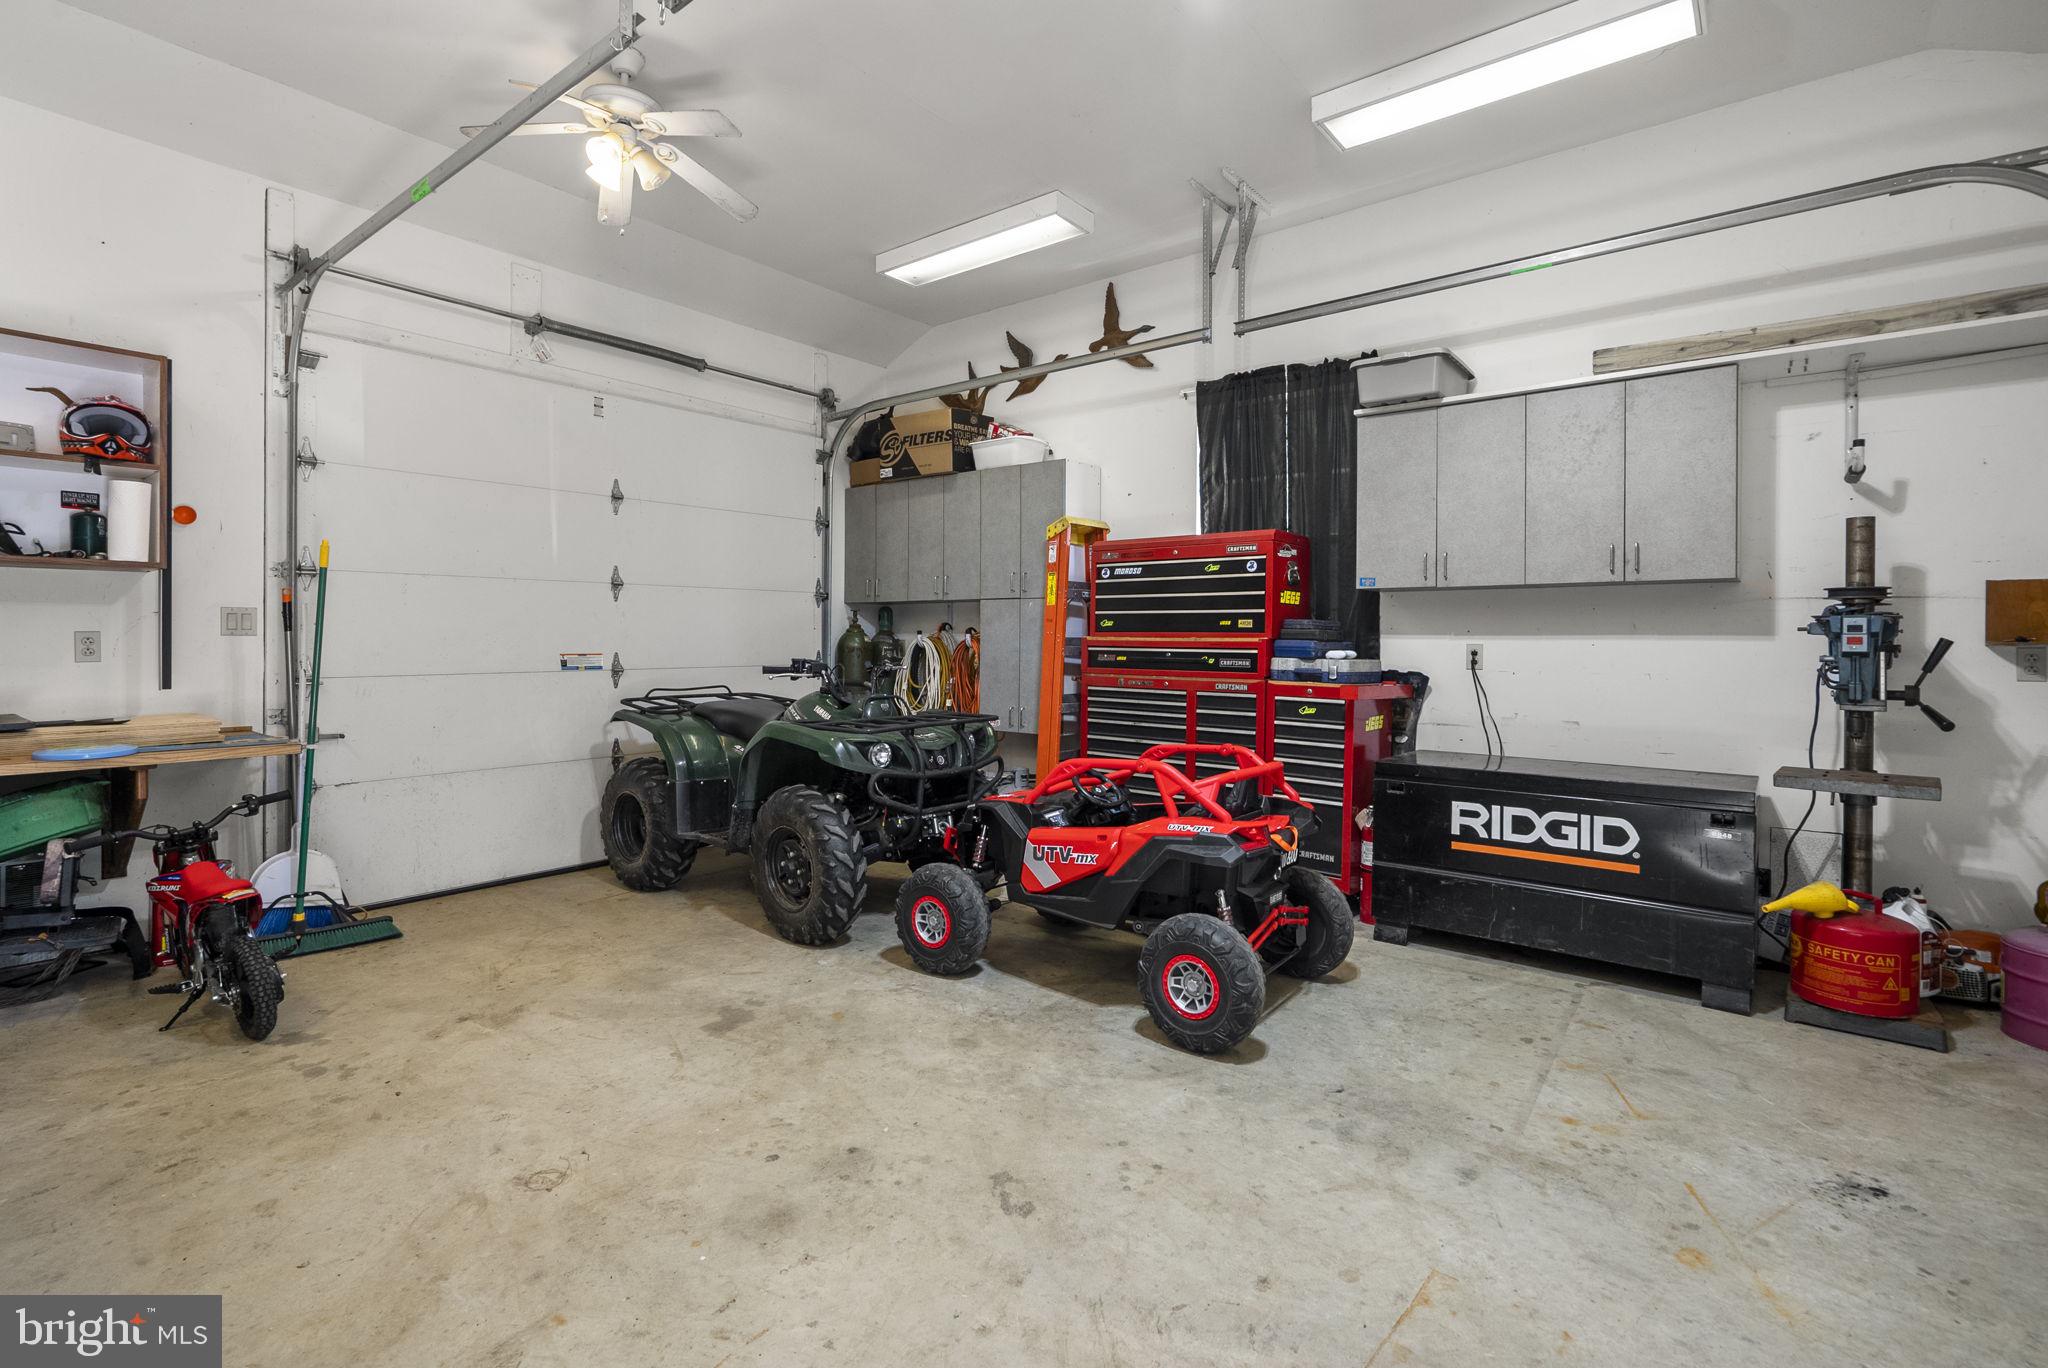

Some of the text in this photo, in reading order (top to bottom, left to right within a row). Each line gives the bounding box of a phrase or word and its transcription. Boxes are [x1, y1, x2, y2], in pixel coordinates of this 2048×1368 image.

[953, 423, 978, 433] BREATHE
[953, 430, 971, 439] YOUR
[902, 430, 952, 447] FILTERS
[1280, 590, 1300, 605] JEGS
[1220, 659, 1250, 667] CRAFTSMAN
[1215, 683, 1248, 691] CRAFTSMAN
[813, 704, 832, 720] YAMAHA
[1365, 715, 1384, 732] JEGS
[1451, 800, 1640, 856] RIDGID
[1807, 942, 1895, 968] SAFETY CAN
